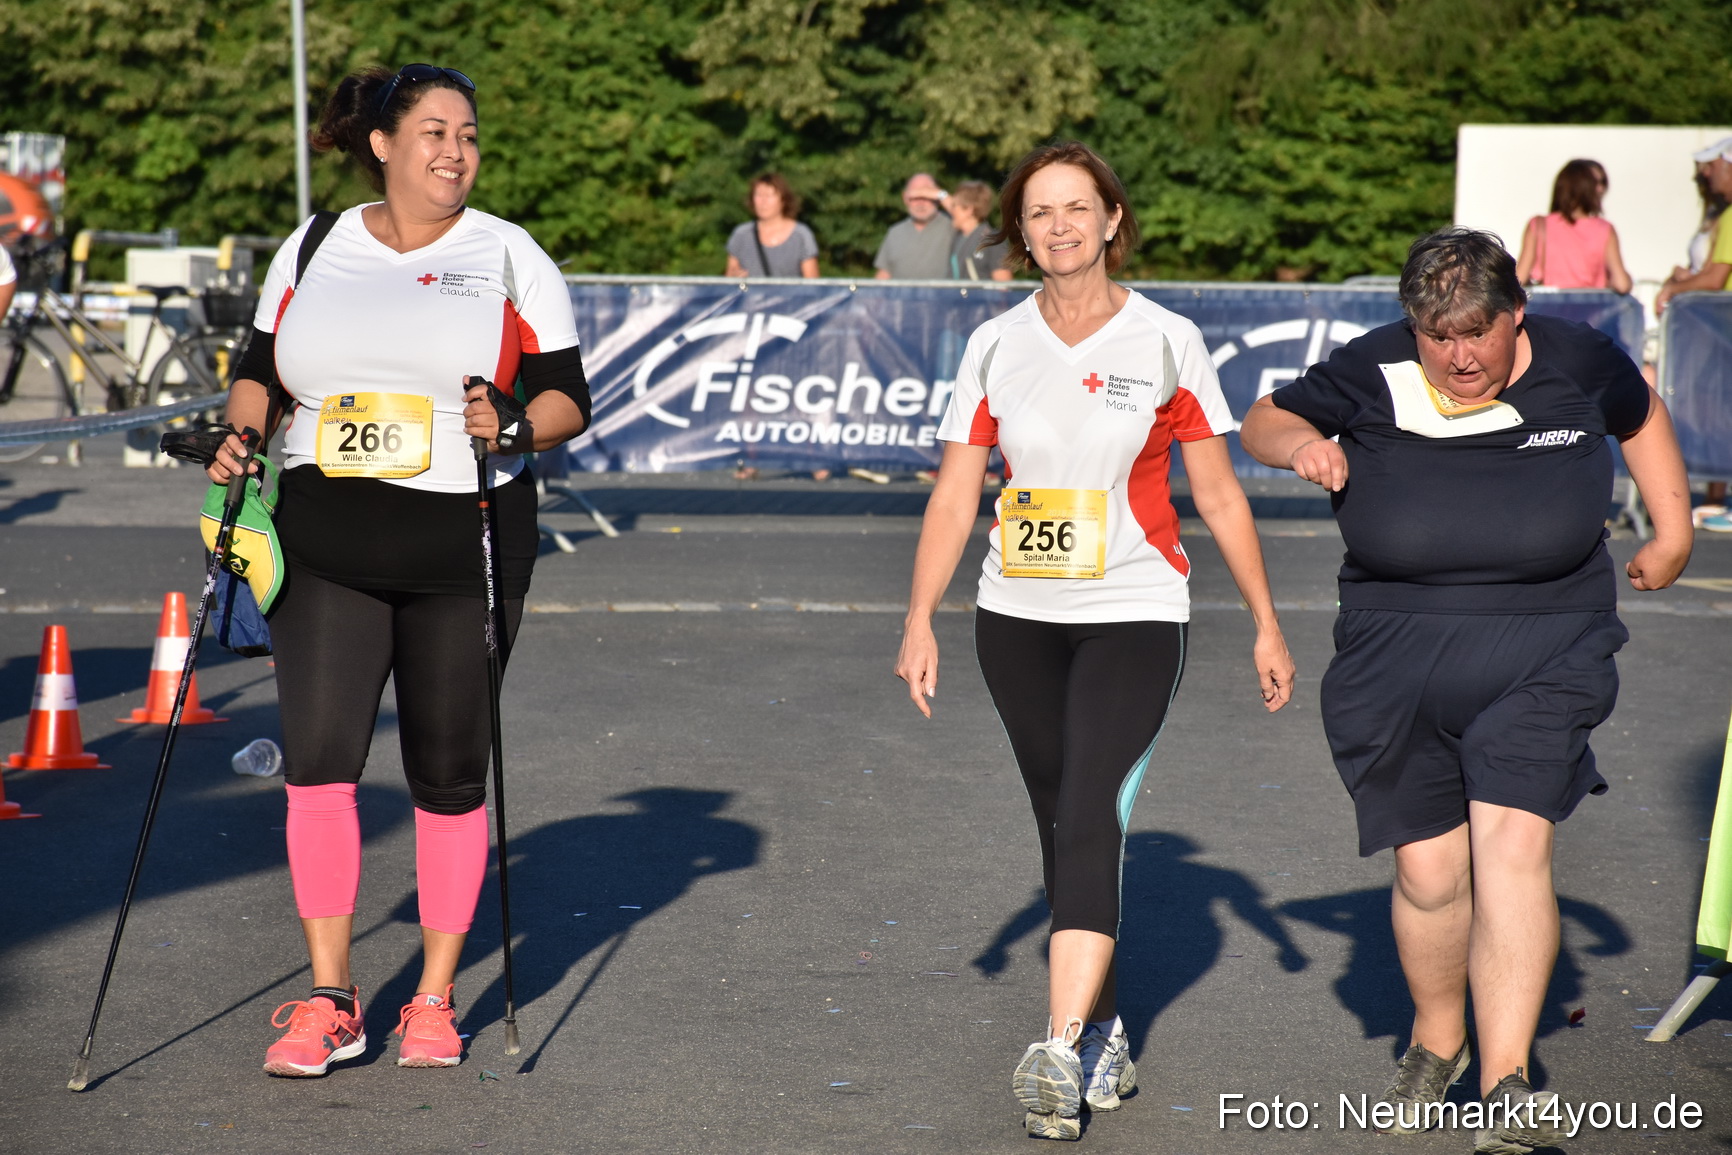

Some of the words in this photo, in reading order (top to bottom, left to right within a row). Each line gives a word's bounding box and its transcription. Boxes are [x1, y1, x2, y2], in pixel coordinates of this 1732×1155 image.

[440, 287, 479, 298] Claudia
[1108, 382, 1130, 390] Rotes
[1109, 375, 1153, 387] Bayerisches
[690, 361, 959, 418] Fischer
[1108, 389, 1129, 397] Kreuz
[1106, 399, 1137, 412] Maria
[338, 423, 402, 453] 266
[715, 420, 937, 447] AUTOMOBILE
[342, 454, 363, 462] Wille
[365, 454, 398, 463] Claudia
[1018, 521, 1078, 553] 256
[1024, 554, 1044, 562] Spital
[1047, 554, 1070, 562] Maria
